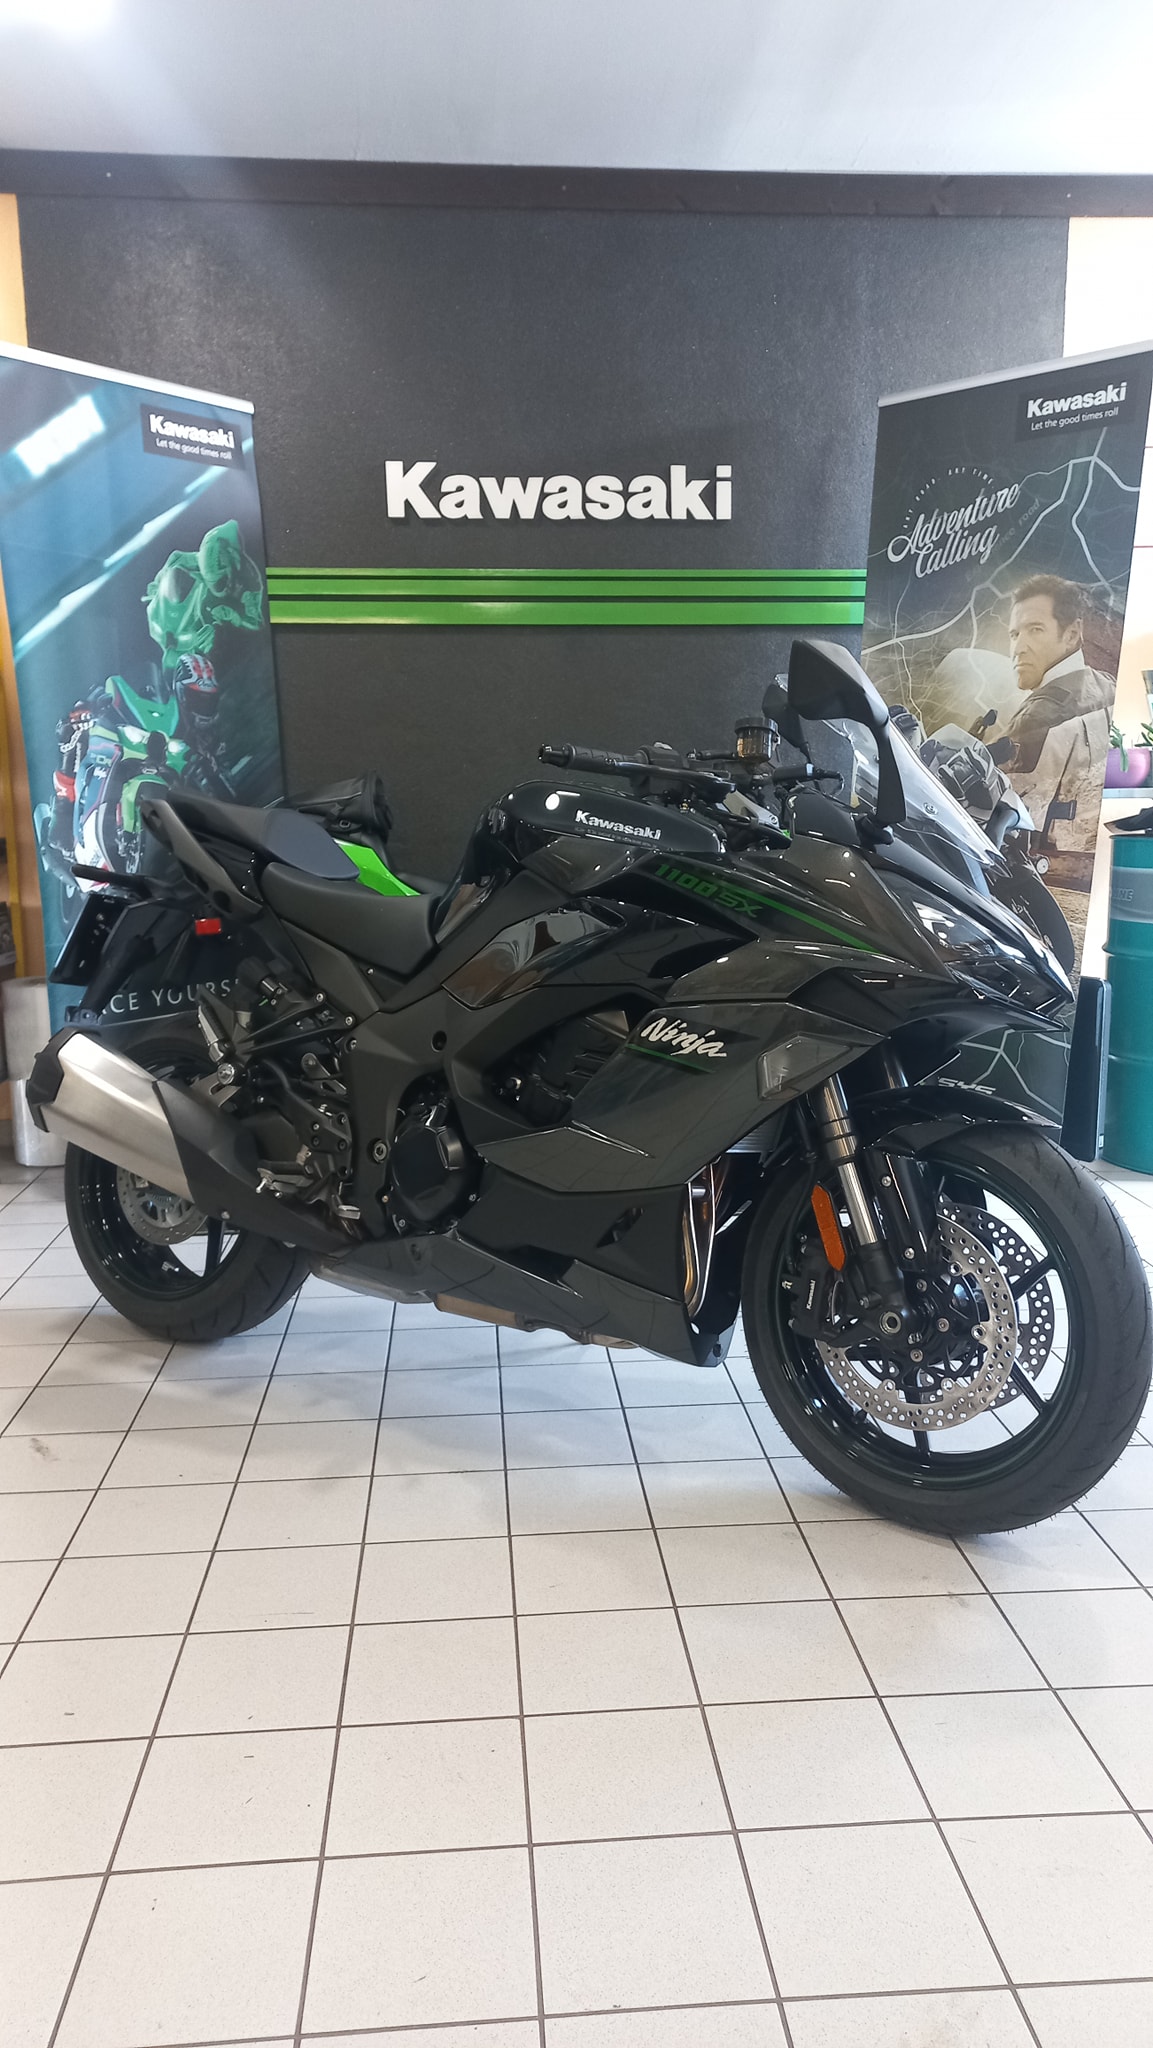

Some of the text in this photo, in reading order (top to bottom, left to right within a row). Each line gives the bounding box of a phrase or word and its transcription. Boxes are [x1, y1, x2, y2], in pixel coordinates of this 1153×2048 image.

[1027, 382, 1127, 418] Kawasaki
[149, 414, 235, 448] Kawasaki
[1031, 406, 1119, 431] Let the good times roll
[156, 438, 232, 460] Let the good times roll
[385, 461, 732, 520] Kawasaki
[887, 484, 1021, 562] Adventure
[915, 525, 999, 578] Calling
[575, 810, 661, 840] Kawasaki
[101, 979, 239, 1014] CE YOURS
[641, 1017, 727, 1057] Ninja
[938, 1077, 996, 1095] SYS
